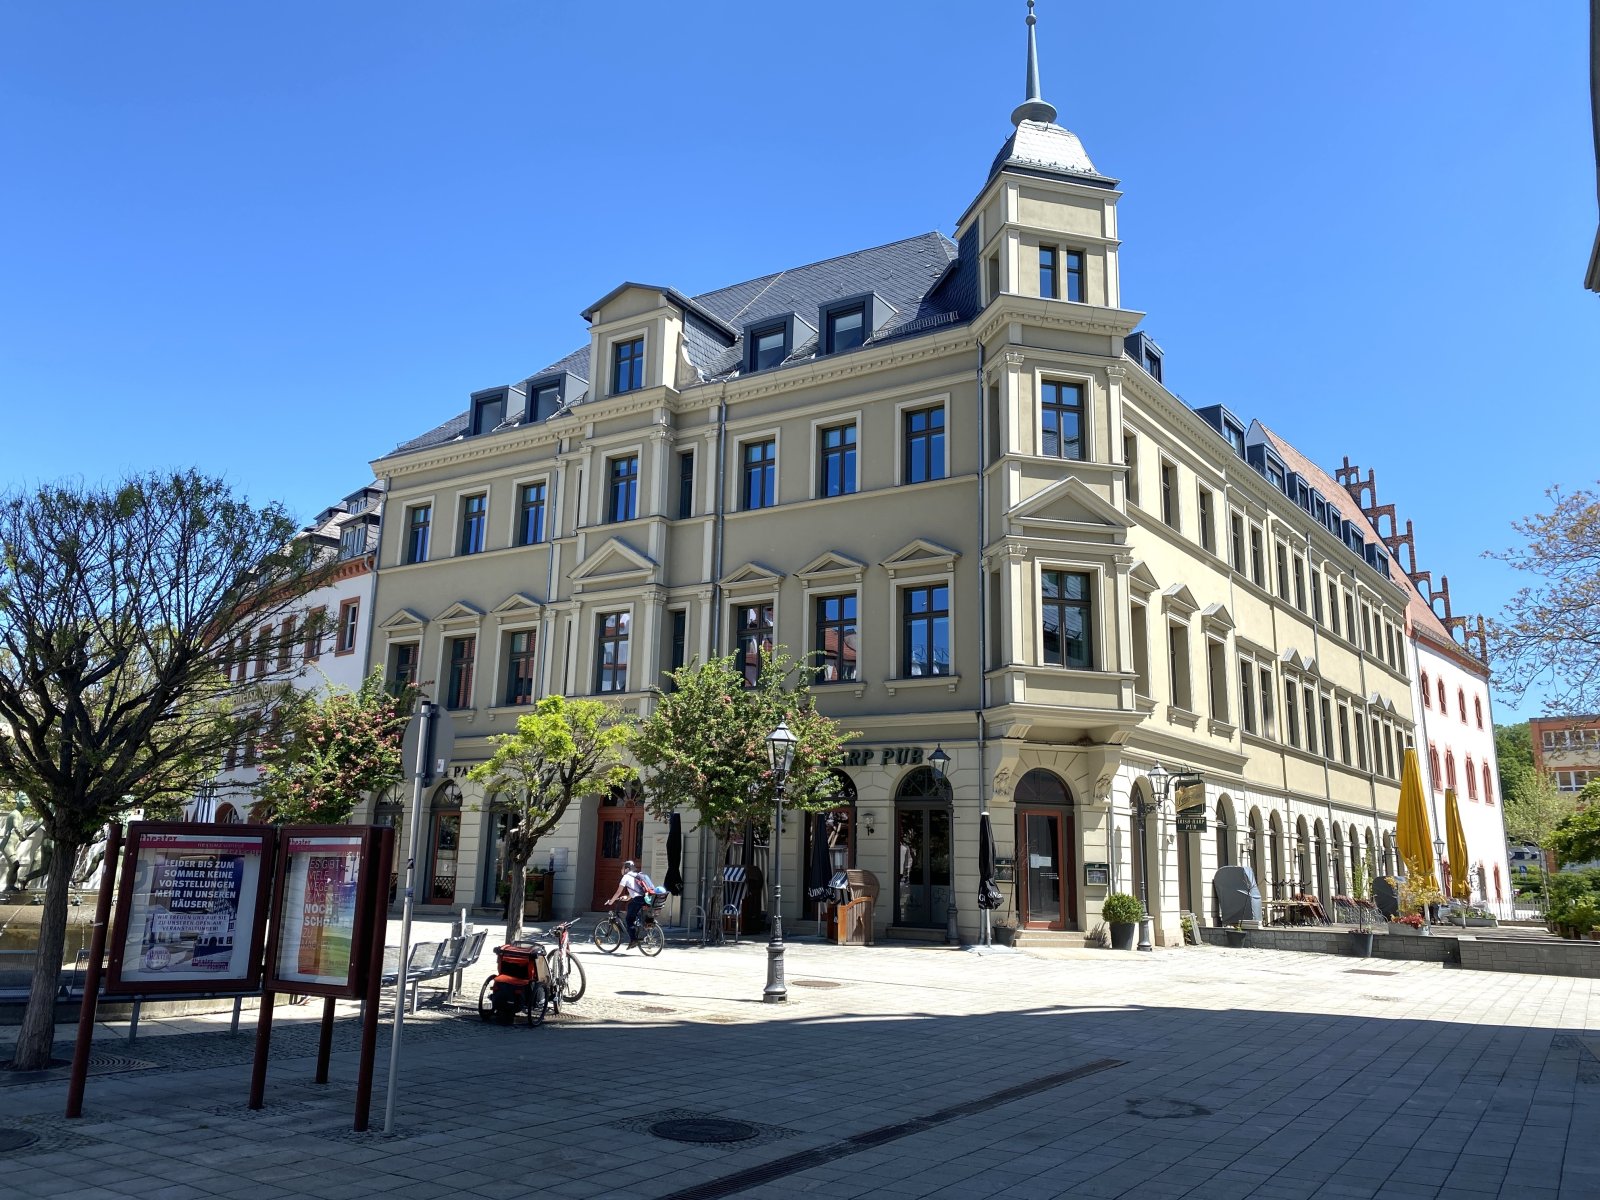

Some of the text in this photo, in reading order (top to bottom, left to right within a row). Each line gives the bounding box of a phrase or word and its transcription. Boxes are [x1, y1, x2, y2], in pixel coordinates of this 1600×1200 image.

[880, 747, 923, 766] PUB
[165, 859, 234, 869] LEIDER BIS ZUM
[164, 870, 233, 879] SOMMER KEINE
[159, 879, 235, 889] VORSTELLUNGEN
[154, 890, 236, 899] MEHR IN UNSEREN
[305, 904, 332, 914] NOCH
